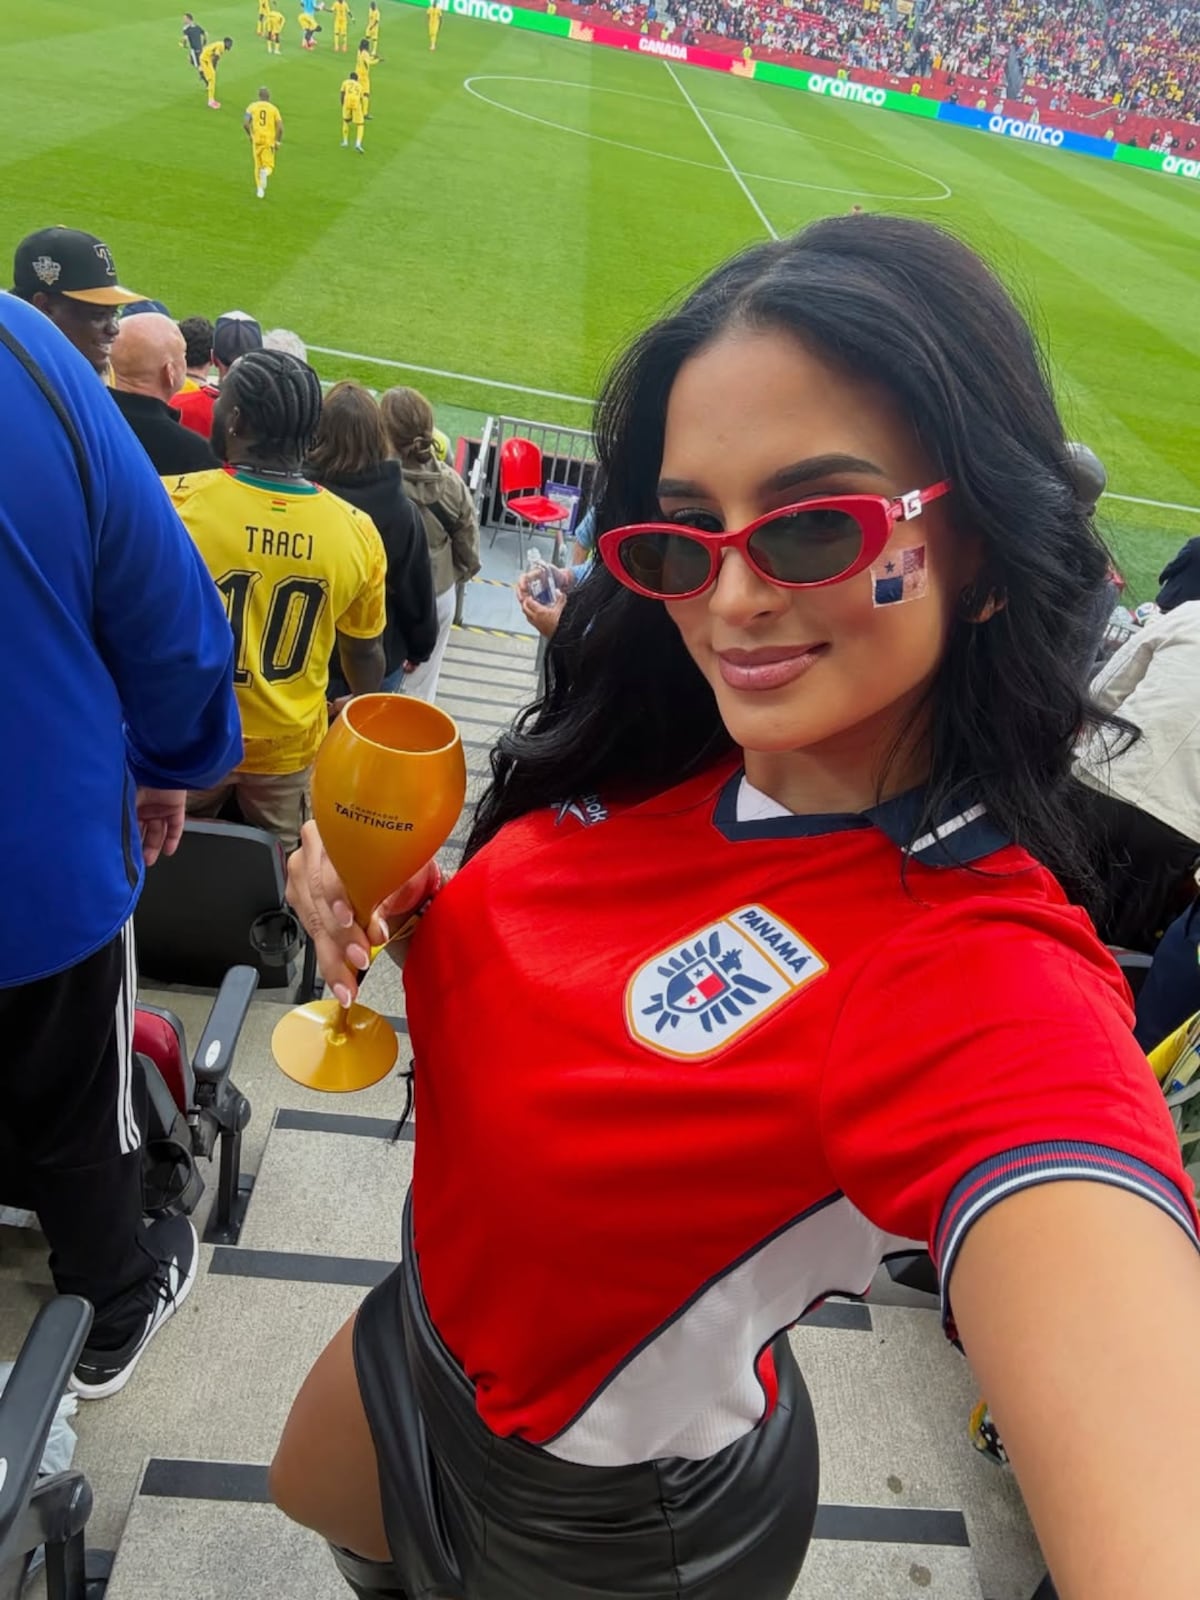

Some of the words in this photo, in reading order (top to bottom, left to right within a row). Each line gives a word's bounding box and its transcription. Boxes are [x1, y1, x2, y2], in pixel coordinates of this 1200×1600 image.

[430, 0, 513, 24] ramco
[639, 38, 687, 60] CANADA
[808, 74, 887, 106] aramco
[259, 110, 267, 127] 9
[988, 115, 1064, 147] aramco
[245, 525, 313, 561] TRACI
[215, 569, 330, 689] 10
[334, 802, 414, 832] TAITTINGER
[738, 910, 812, 974] PANAMÁ
